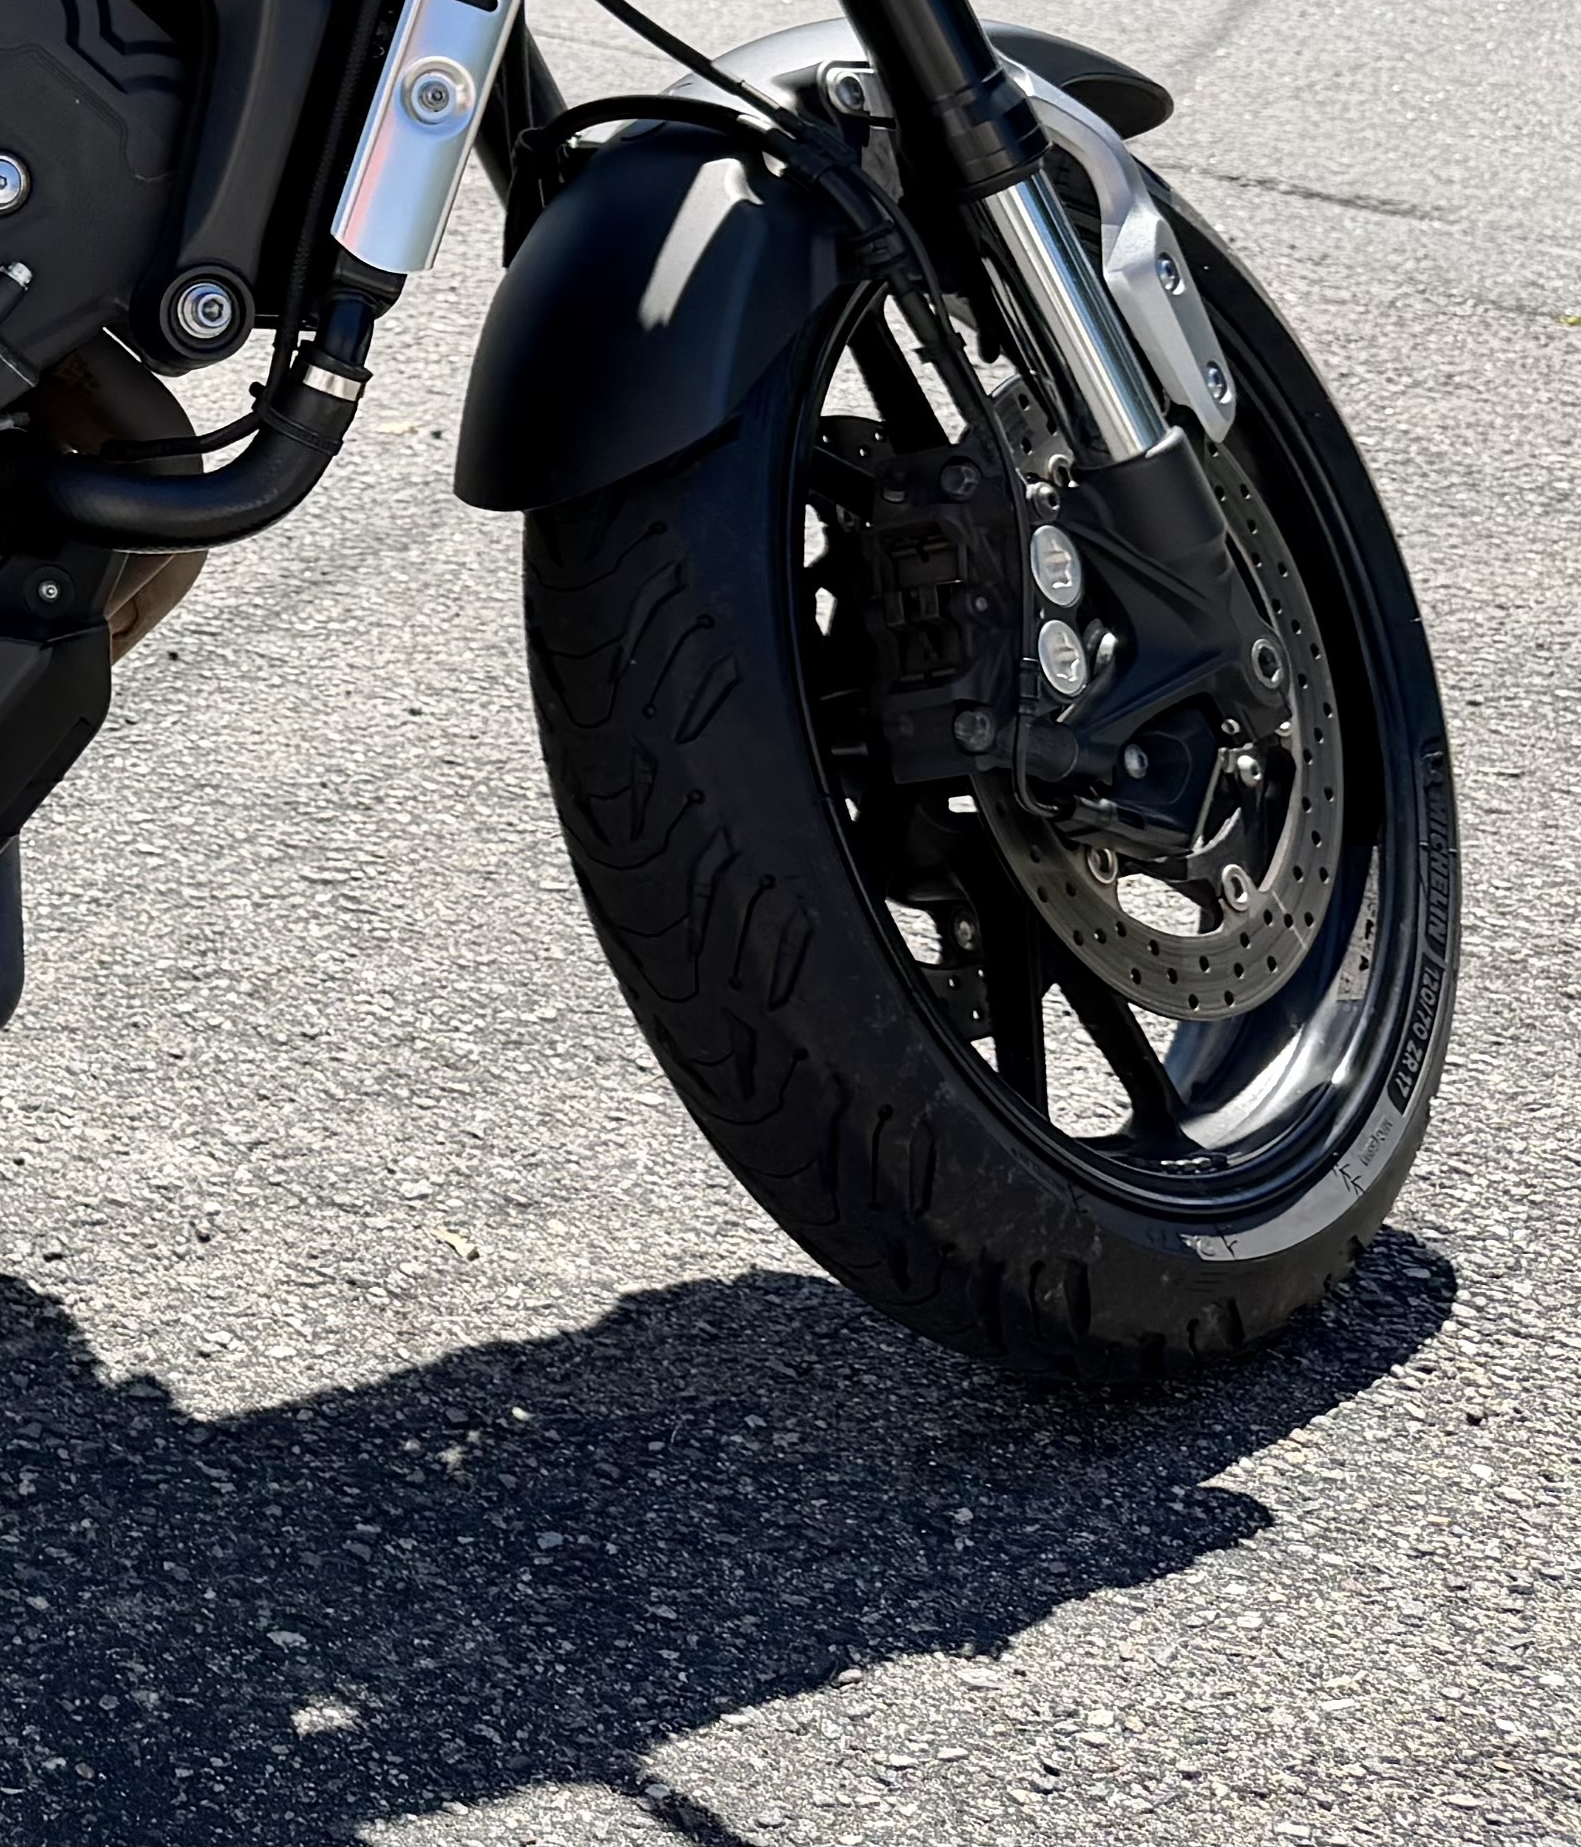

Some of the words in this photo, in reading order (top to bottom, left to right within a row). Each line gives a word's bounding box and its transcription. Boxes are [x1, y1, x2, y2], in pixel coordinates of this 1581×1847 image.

[1425, 790, 1449, 945] MICHELIN
[1411, 966, 1442, 1040] 120/70
[1401, 1038, 1425, 1070] ZR
[1393, 1071, 1412, 1096] 17
